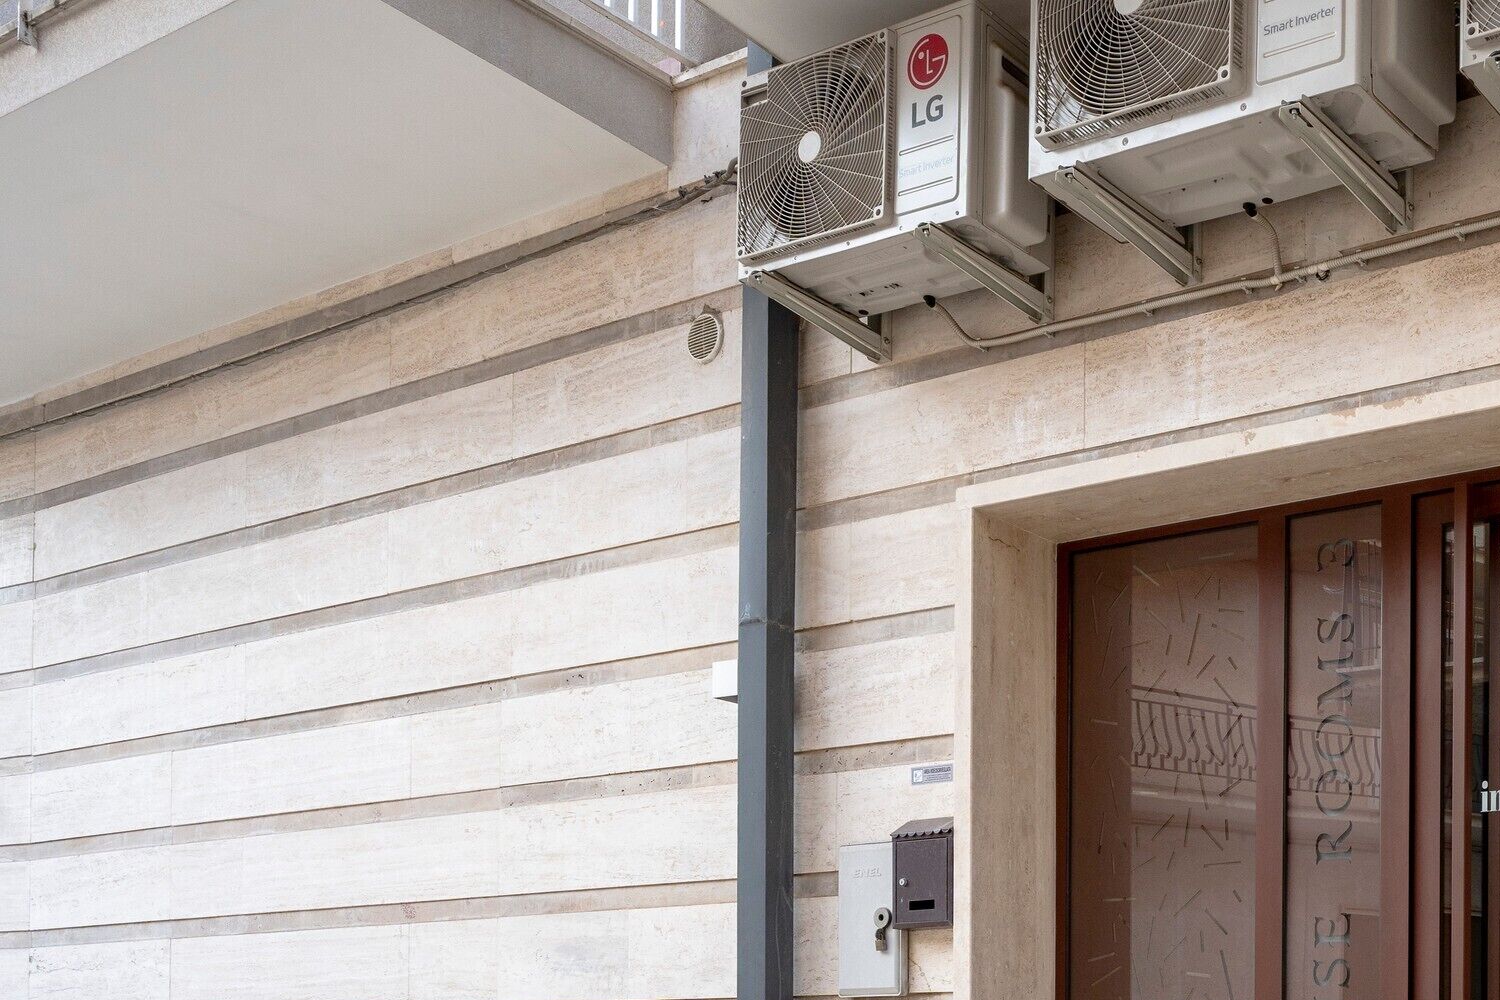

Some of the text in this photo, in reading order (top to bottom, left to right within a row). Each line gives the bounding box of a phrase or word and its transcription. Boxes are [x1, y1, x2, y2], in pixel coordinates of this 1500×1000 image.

[1263, 6, 1336, 36] Smart Inverter
[911, 94, 944, 129] LG
[898, 155, 954, 178] Smart Inverter
[1317, 538, 1354, 572] 3
[1315, 611, 1355, 866] ROOMS
[852, 864, 882, 879] ENEL
